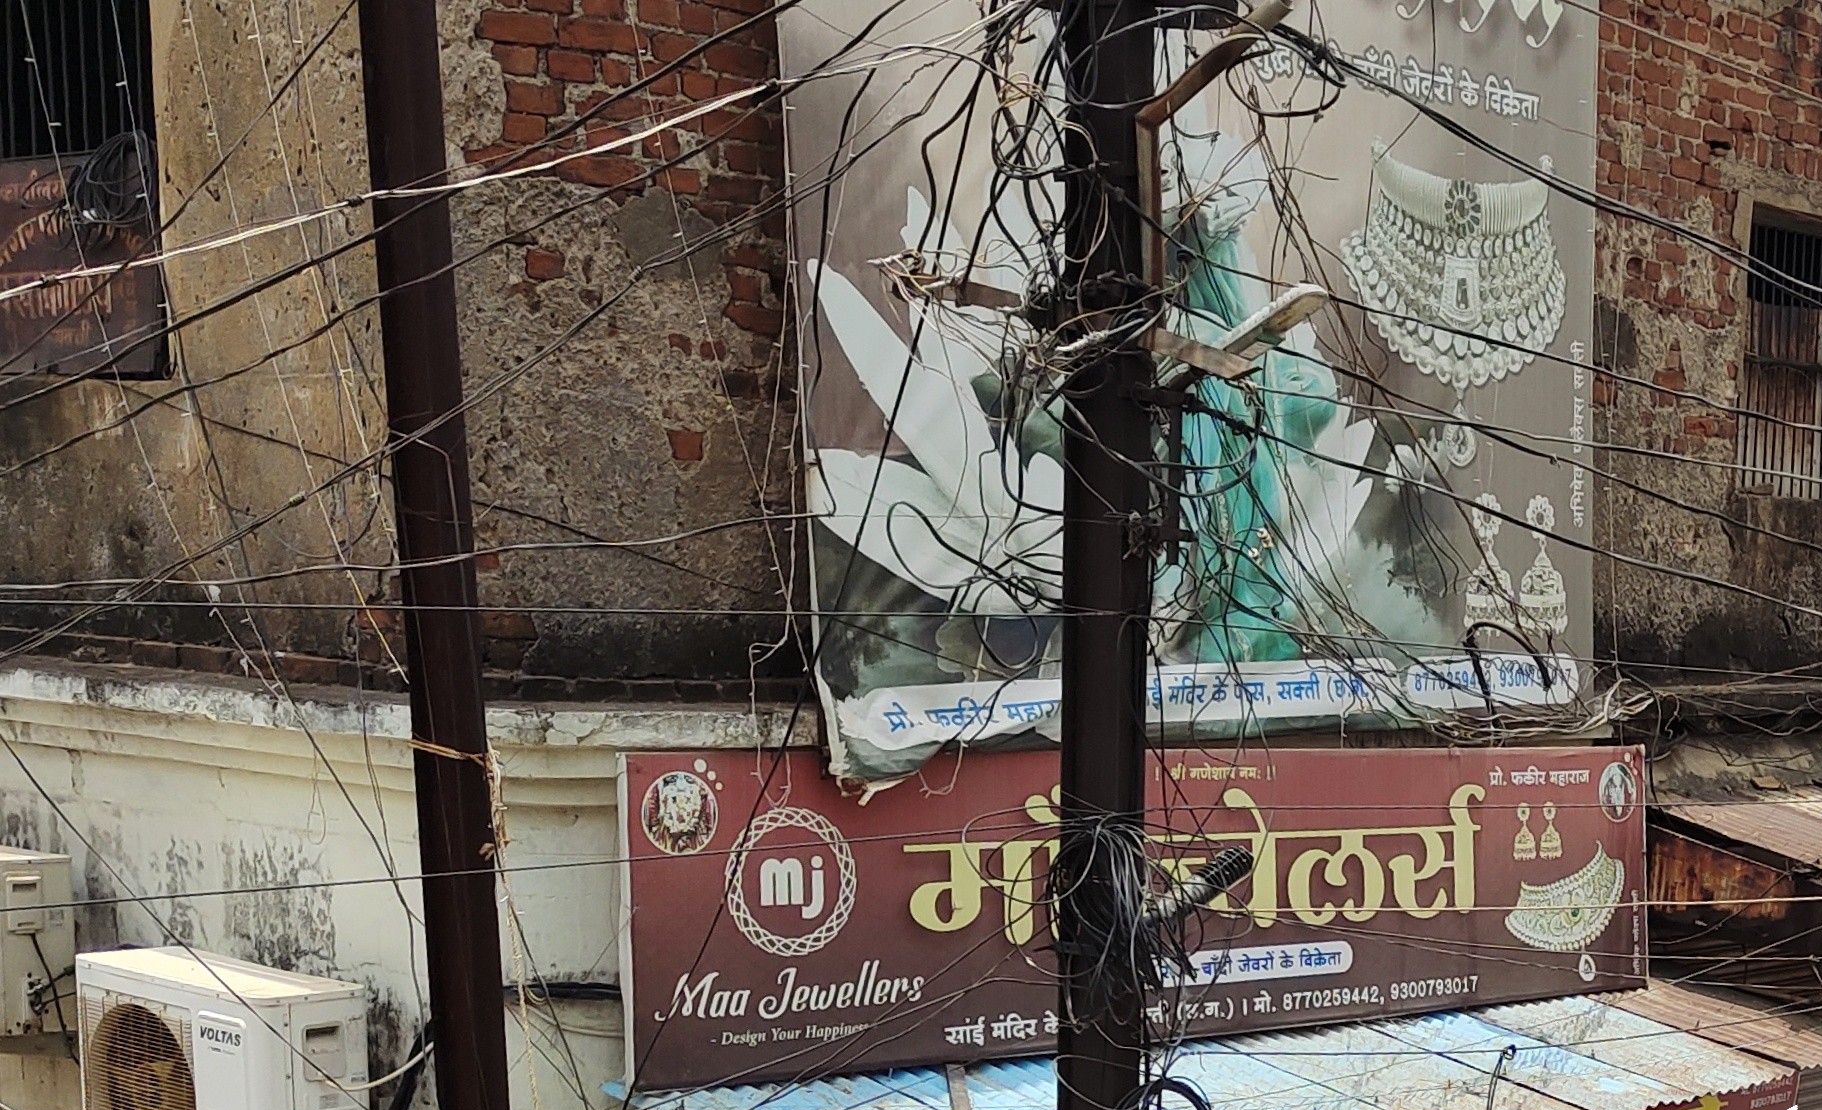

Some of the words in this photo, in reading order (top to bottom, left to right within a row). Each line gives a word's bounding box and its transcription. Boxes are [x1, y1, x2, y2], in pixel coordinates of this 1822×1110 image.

[1459, 70, 1481, 108] के
[1485, 75, 1540, 120] विक्रेता
[1549, 769, 1590, 786] महाराज
[759, 856, 824, 920] mj
[1237, 947, 1275, 972] जेवरों
[1279, 950, 1294, 969] के
[1299, 947, 1341, 967] विक्रेता
[655, 971, 750, 1022] Maa
[758, 960, 925, 1020] Jewellers
[1255, 992, 1277, 1015] मो.
[1282, 984, 1385, 1013] 8770259442,
[1390, 976, 1480, 1000] 9300793017
[200, 1024, 242, 1047] VOLTAS
[721, 1028, 766, 1046] Design
[771, 1024, 802, 1042] Your
[990, 1013, 1037, 1040] मंदिर
